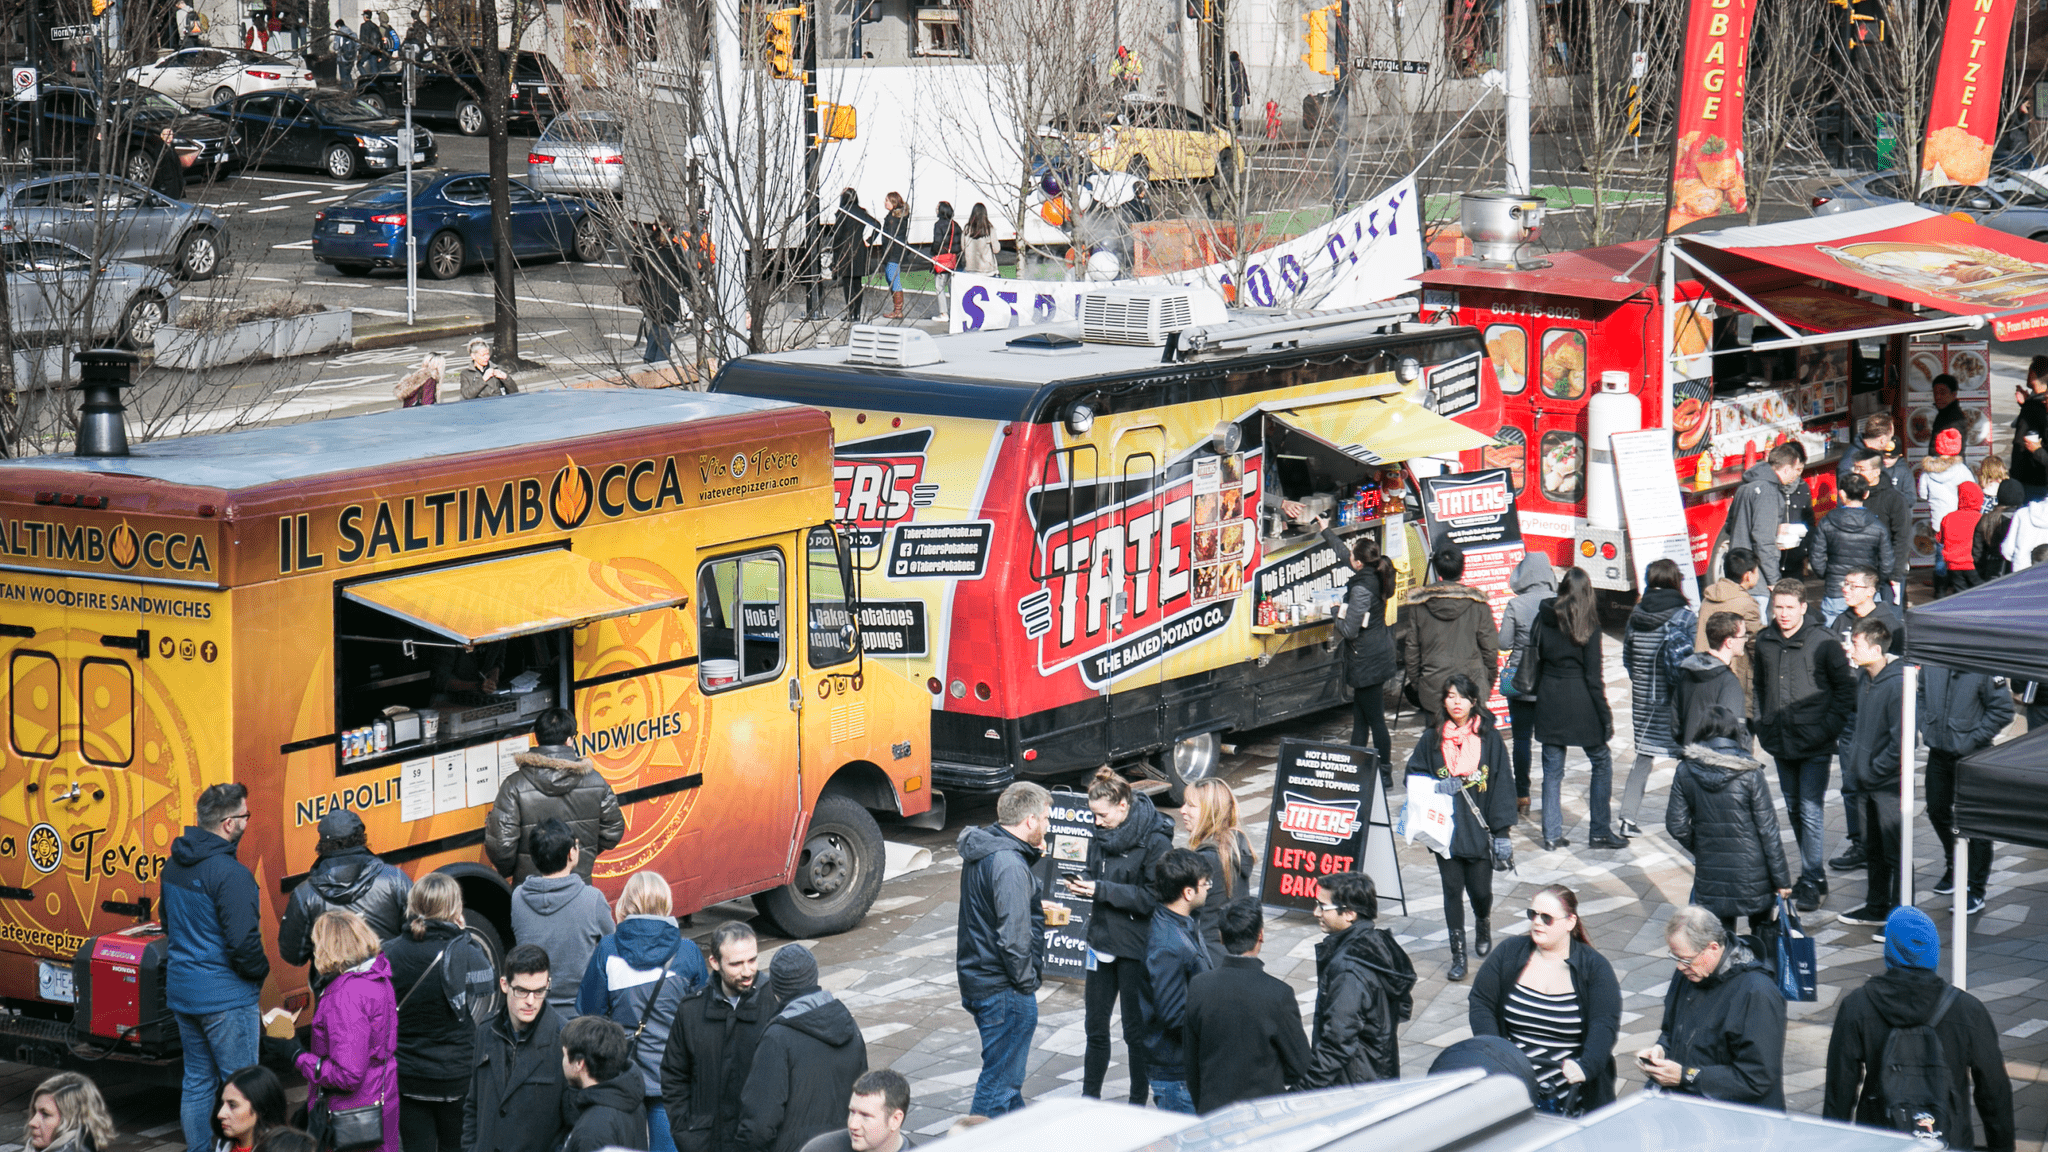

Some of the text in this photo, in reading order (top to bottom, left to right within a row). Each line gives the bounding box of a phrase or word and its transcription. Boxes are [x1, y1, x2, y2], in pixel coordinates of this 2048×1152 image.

[1491, 302, 1581, 320] 604 715-8026
[700, 446, 798, 484] Via Tevere
[699, 476, 799, 501] viateverepizzeria.com
[1439, 486, 1504, 515] TATERS
[279, 453, 685, 575] IL SALTIMBOCCA
[1261, 569, 1278, 593] Hot
[1286, 556, 1310, 584] Fresh
[30, 586, 107, 610] WOODFIRE
[111, 594, 212, 620] SANDWICHES
[745, 609, 767, 627] Hot
[861, 608, 914, 627] otatoes
[1096, 651, 1121, 676] THE
[1123, 637, 1161, 668] BAKED
[1161, 620, 1201, 651] POTATO
[1204, 608, 1224, 629] CO.
[1296, 759, 1357, 774] BAKED POTATOES
[1305, 750, 1350, 763] HOT & FRESH
[413, 768, 422, 778] $9
[1288, 775, 1360, 792] DELICIOUS TOPPINGS
[1315, 770, 1334, 779] WITH
[1287, 805, 1353, 834] TATERS
[70, 828, 165, 882] Tever
[1273, 846, 1354, 875] LET'S GET
[1044, 930, 1086, 951] Tevere
[112, 965, 136, 975] HONDA
[1048, 953, 1082, 967] Express
